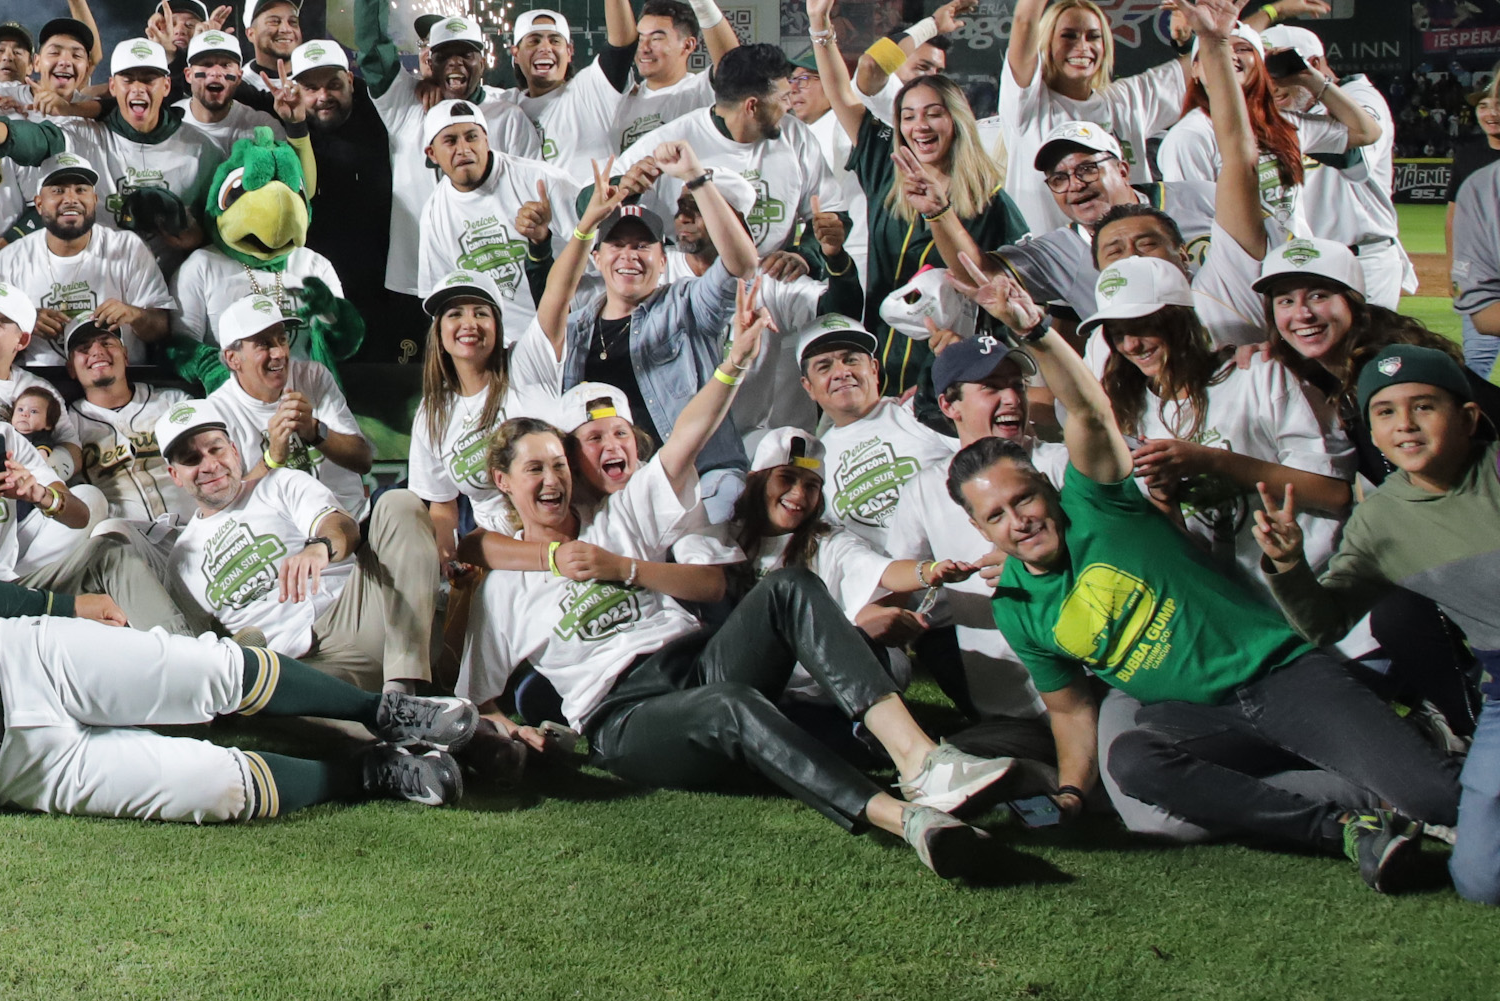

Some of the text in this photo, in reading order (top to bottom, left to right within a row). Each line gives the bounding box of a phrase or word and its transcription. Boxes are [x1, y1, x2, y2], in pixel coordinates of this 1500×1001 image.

[1353, 41, 1400, 58] INN
[125, 166, 164, 183] Pericos
[463, 215, 499, 239] Pericos
[50, 280, 89, 299] Pericos
[978, 336, 997, 355] P
[839, 436, 881, 473] Pericos
[843, 456, 888, 486] CAMPEÓN
[848, 471, 895, 500] ZONA SUR
[858, 488, 900, 517] 2023
[204, 517, 236, 563] Pericos
[211, 537, 249, 576] CAMPEÓN
[221, 552, 260, 591] ZONA SUR
[573, 593, 602, 617] ZONA
[587, 601, 632, 637] 2023
[1115, 597, 1176, 682] BUBBA GUMP
[1142, 642, 1162, 670] SHRIMP
[1151, 643, 1172, 670] CANCUN
